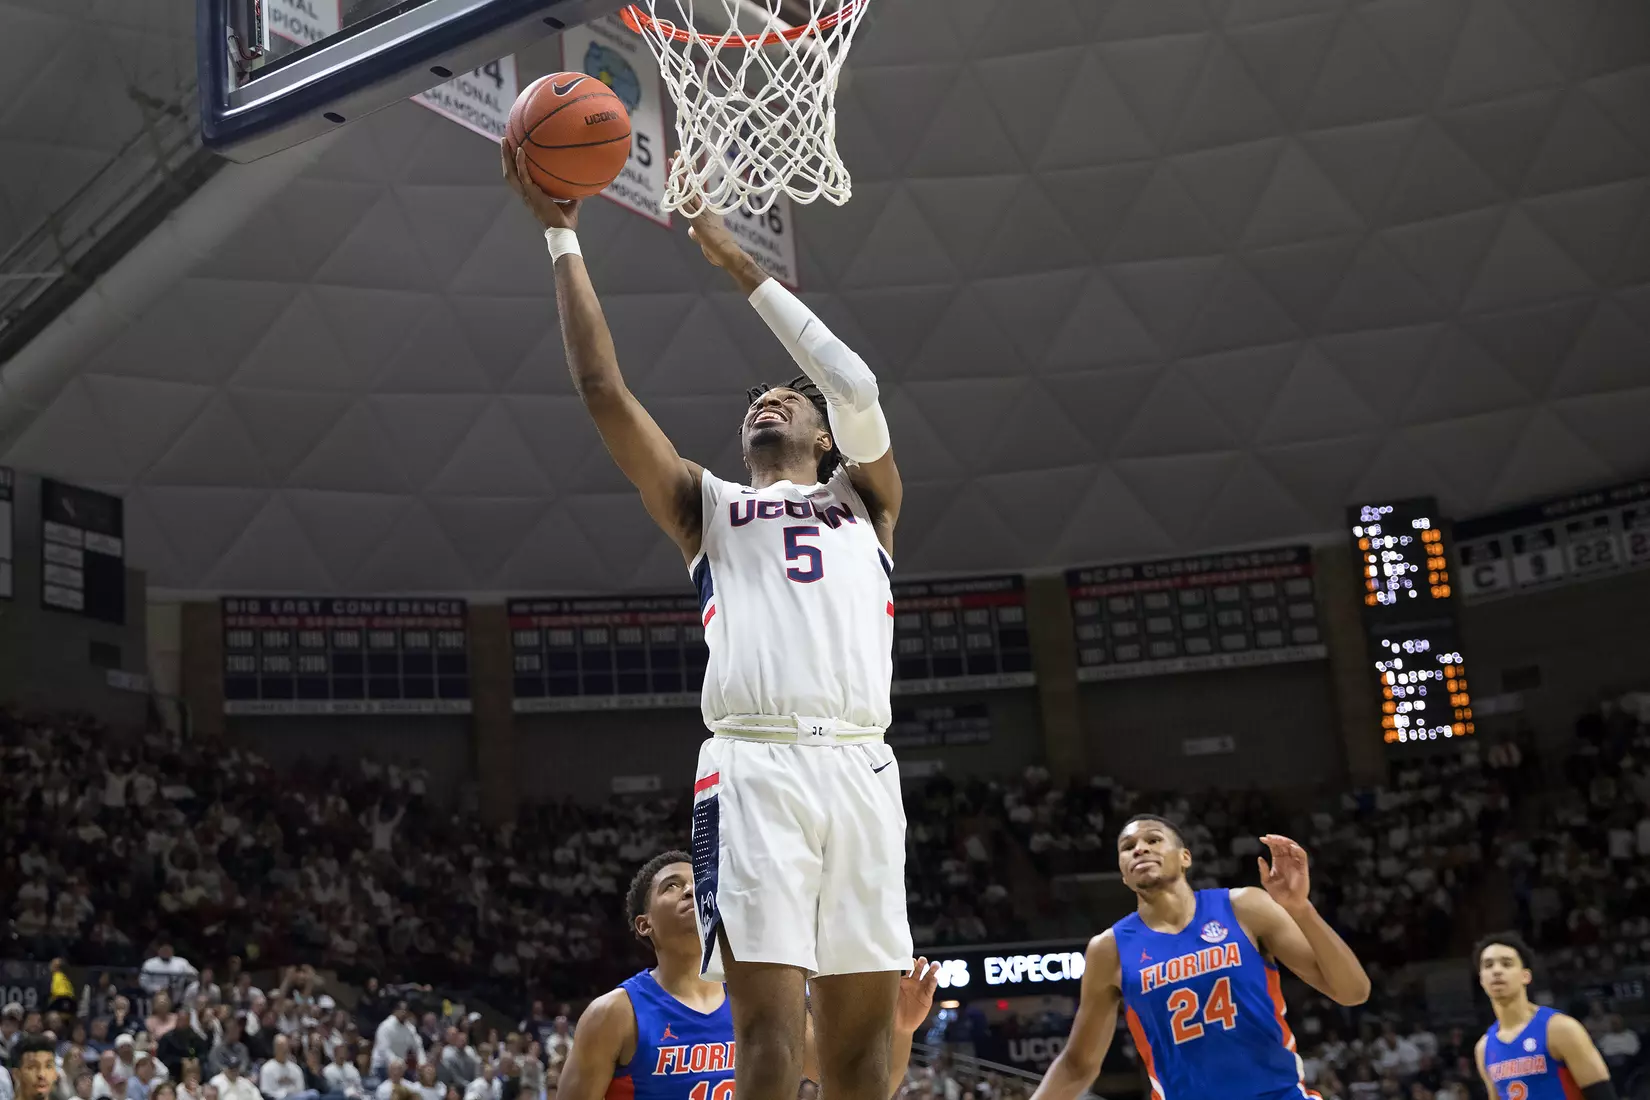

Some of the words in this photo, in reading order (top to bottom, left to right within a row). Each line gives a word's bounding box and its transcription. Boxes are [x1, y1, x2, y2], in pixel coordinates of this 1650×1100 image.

[584, 111, 619, 126] UCONN
[782, 525, 825, 584] 5
[1575, 540, 1613, 567] 22
[270, 600, 321, 614] EAST
[332, 600, 462, 614] CONFERENCE
[1139, 942, 1242, 995] FLORIDA
[1166, 976, 1238, 1045] 24
[651, 1041, 736, 1076] FLORI
[1487, 1053, 1548, 1083] FLORIDA
